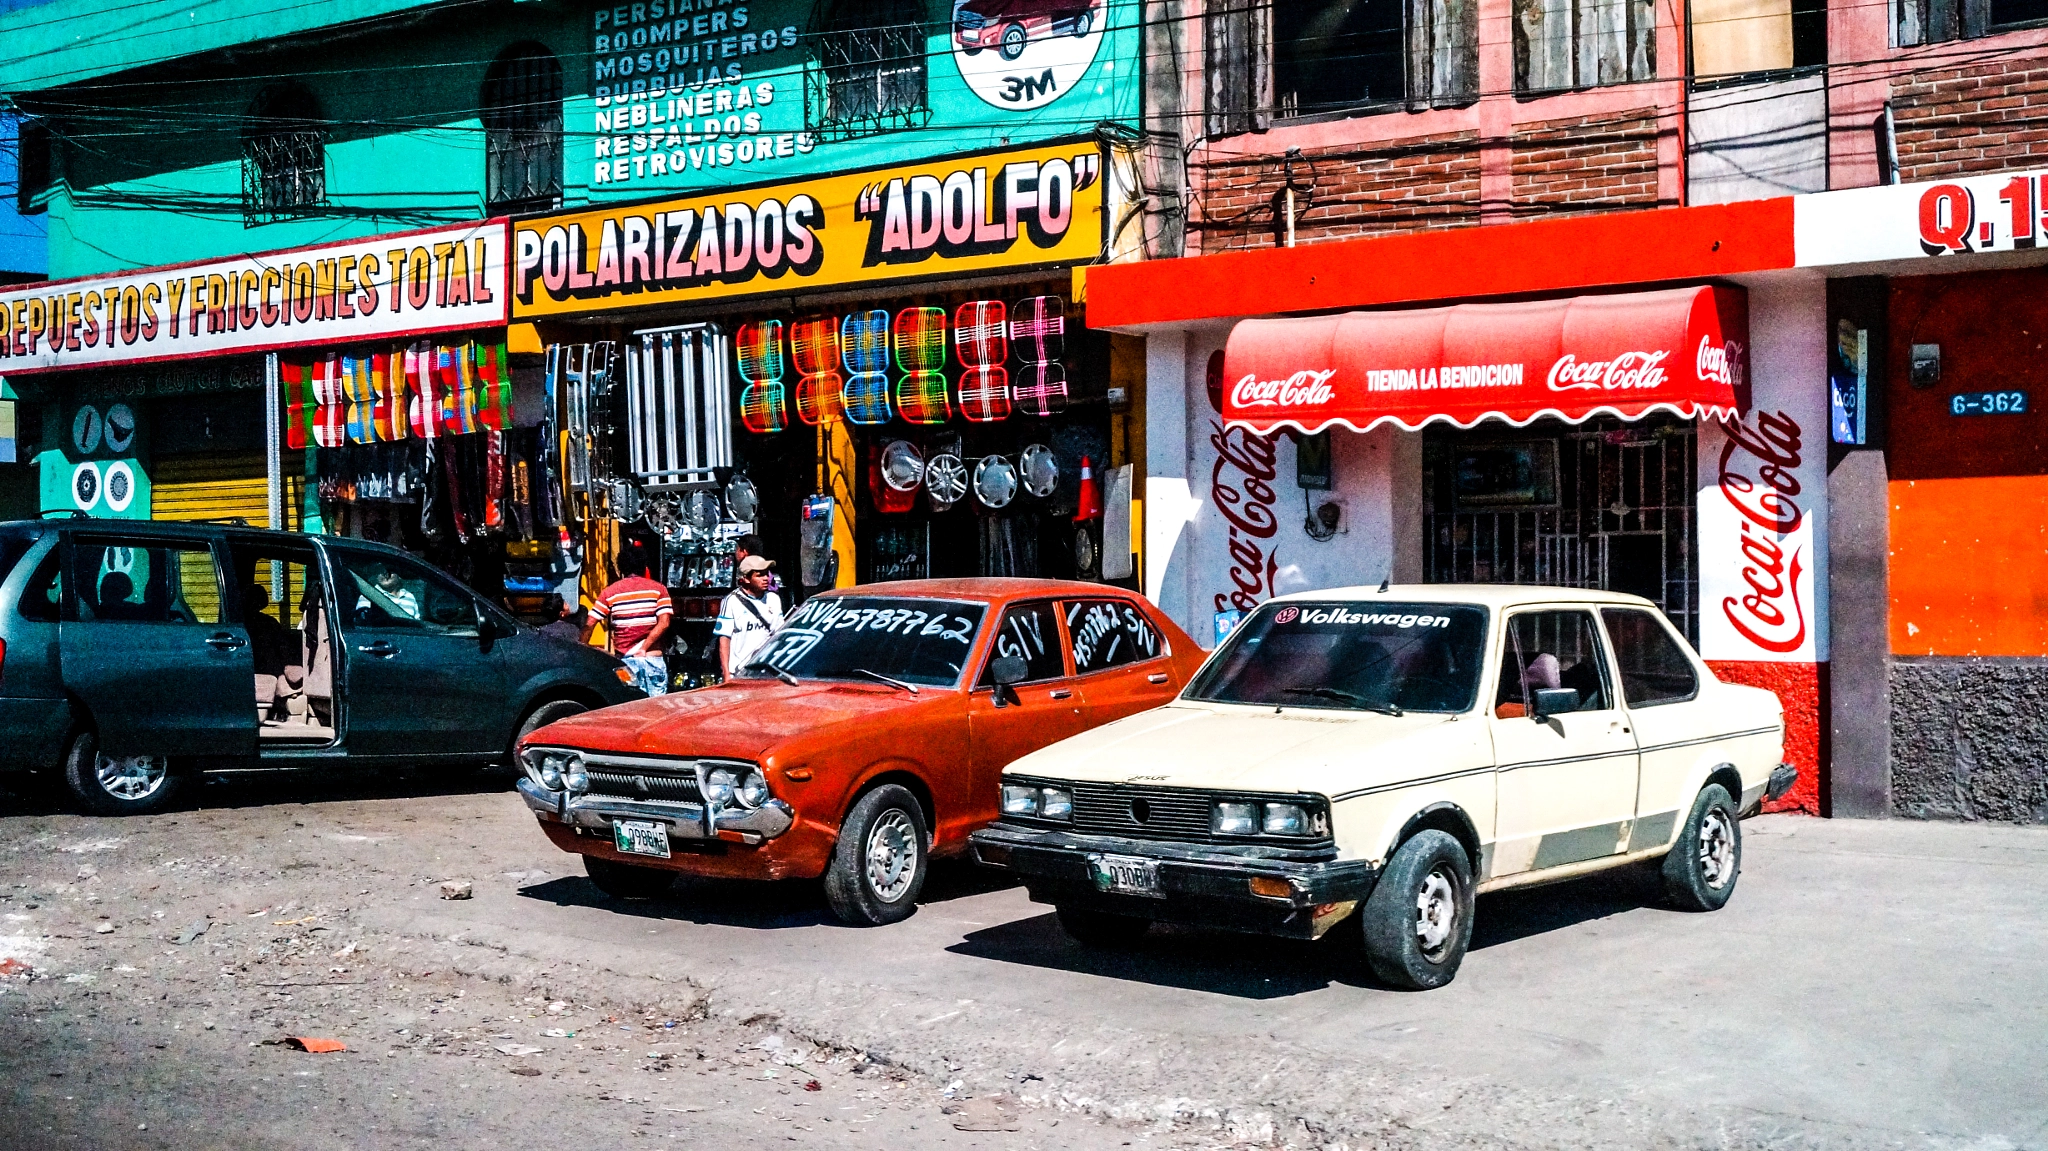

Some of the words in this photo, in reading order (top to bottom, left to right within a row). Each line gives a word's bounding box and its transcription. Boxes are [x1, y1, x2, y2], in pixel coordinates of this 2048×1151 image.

[595, 7, 749, 54] BOOMPERS
[595, 26, 798, 81] MOSQUITEROS
[595, 62, 743, 107] BURBUJAS
[595, 82, 775, 132] NEBLINERAS
[998, 67, 1057, 102] 3M
[595, 112, 762, 158] RESPALDOS
[595, 131, 815, 184] RETROVISORES
[1919, 174, 2048, 252] Q.1
[516, 194, 820, 297] POLARIZADOS
[167, 278, 186, 338] Y
[189, 253, 380, 336] FRICCIONES
[387, 237, 494, 313] TOTAL
[1366, 369, 1418, 391] TIENDA
[1420, 370, 1438, 390] LA
[1439, 364, 1524, 388] BENDICION
[1547, 350, 1671, 392] Coca-Cola
[1697, 334, 1744, 386] Coca-Cola
[1231, 369, 1337, 408] Coca-Cola
[1952, 392, 2023, 414] 6-362
[1718, 410, 1806, 653] Coca-Cola
[1299, 608, 1451, 629] Volkswagen
